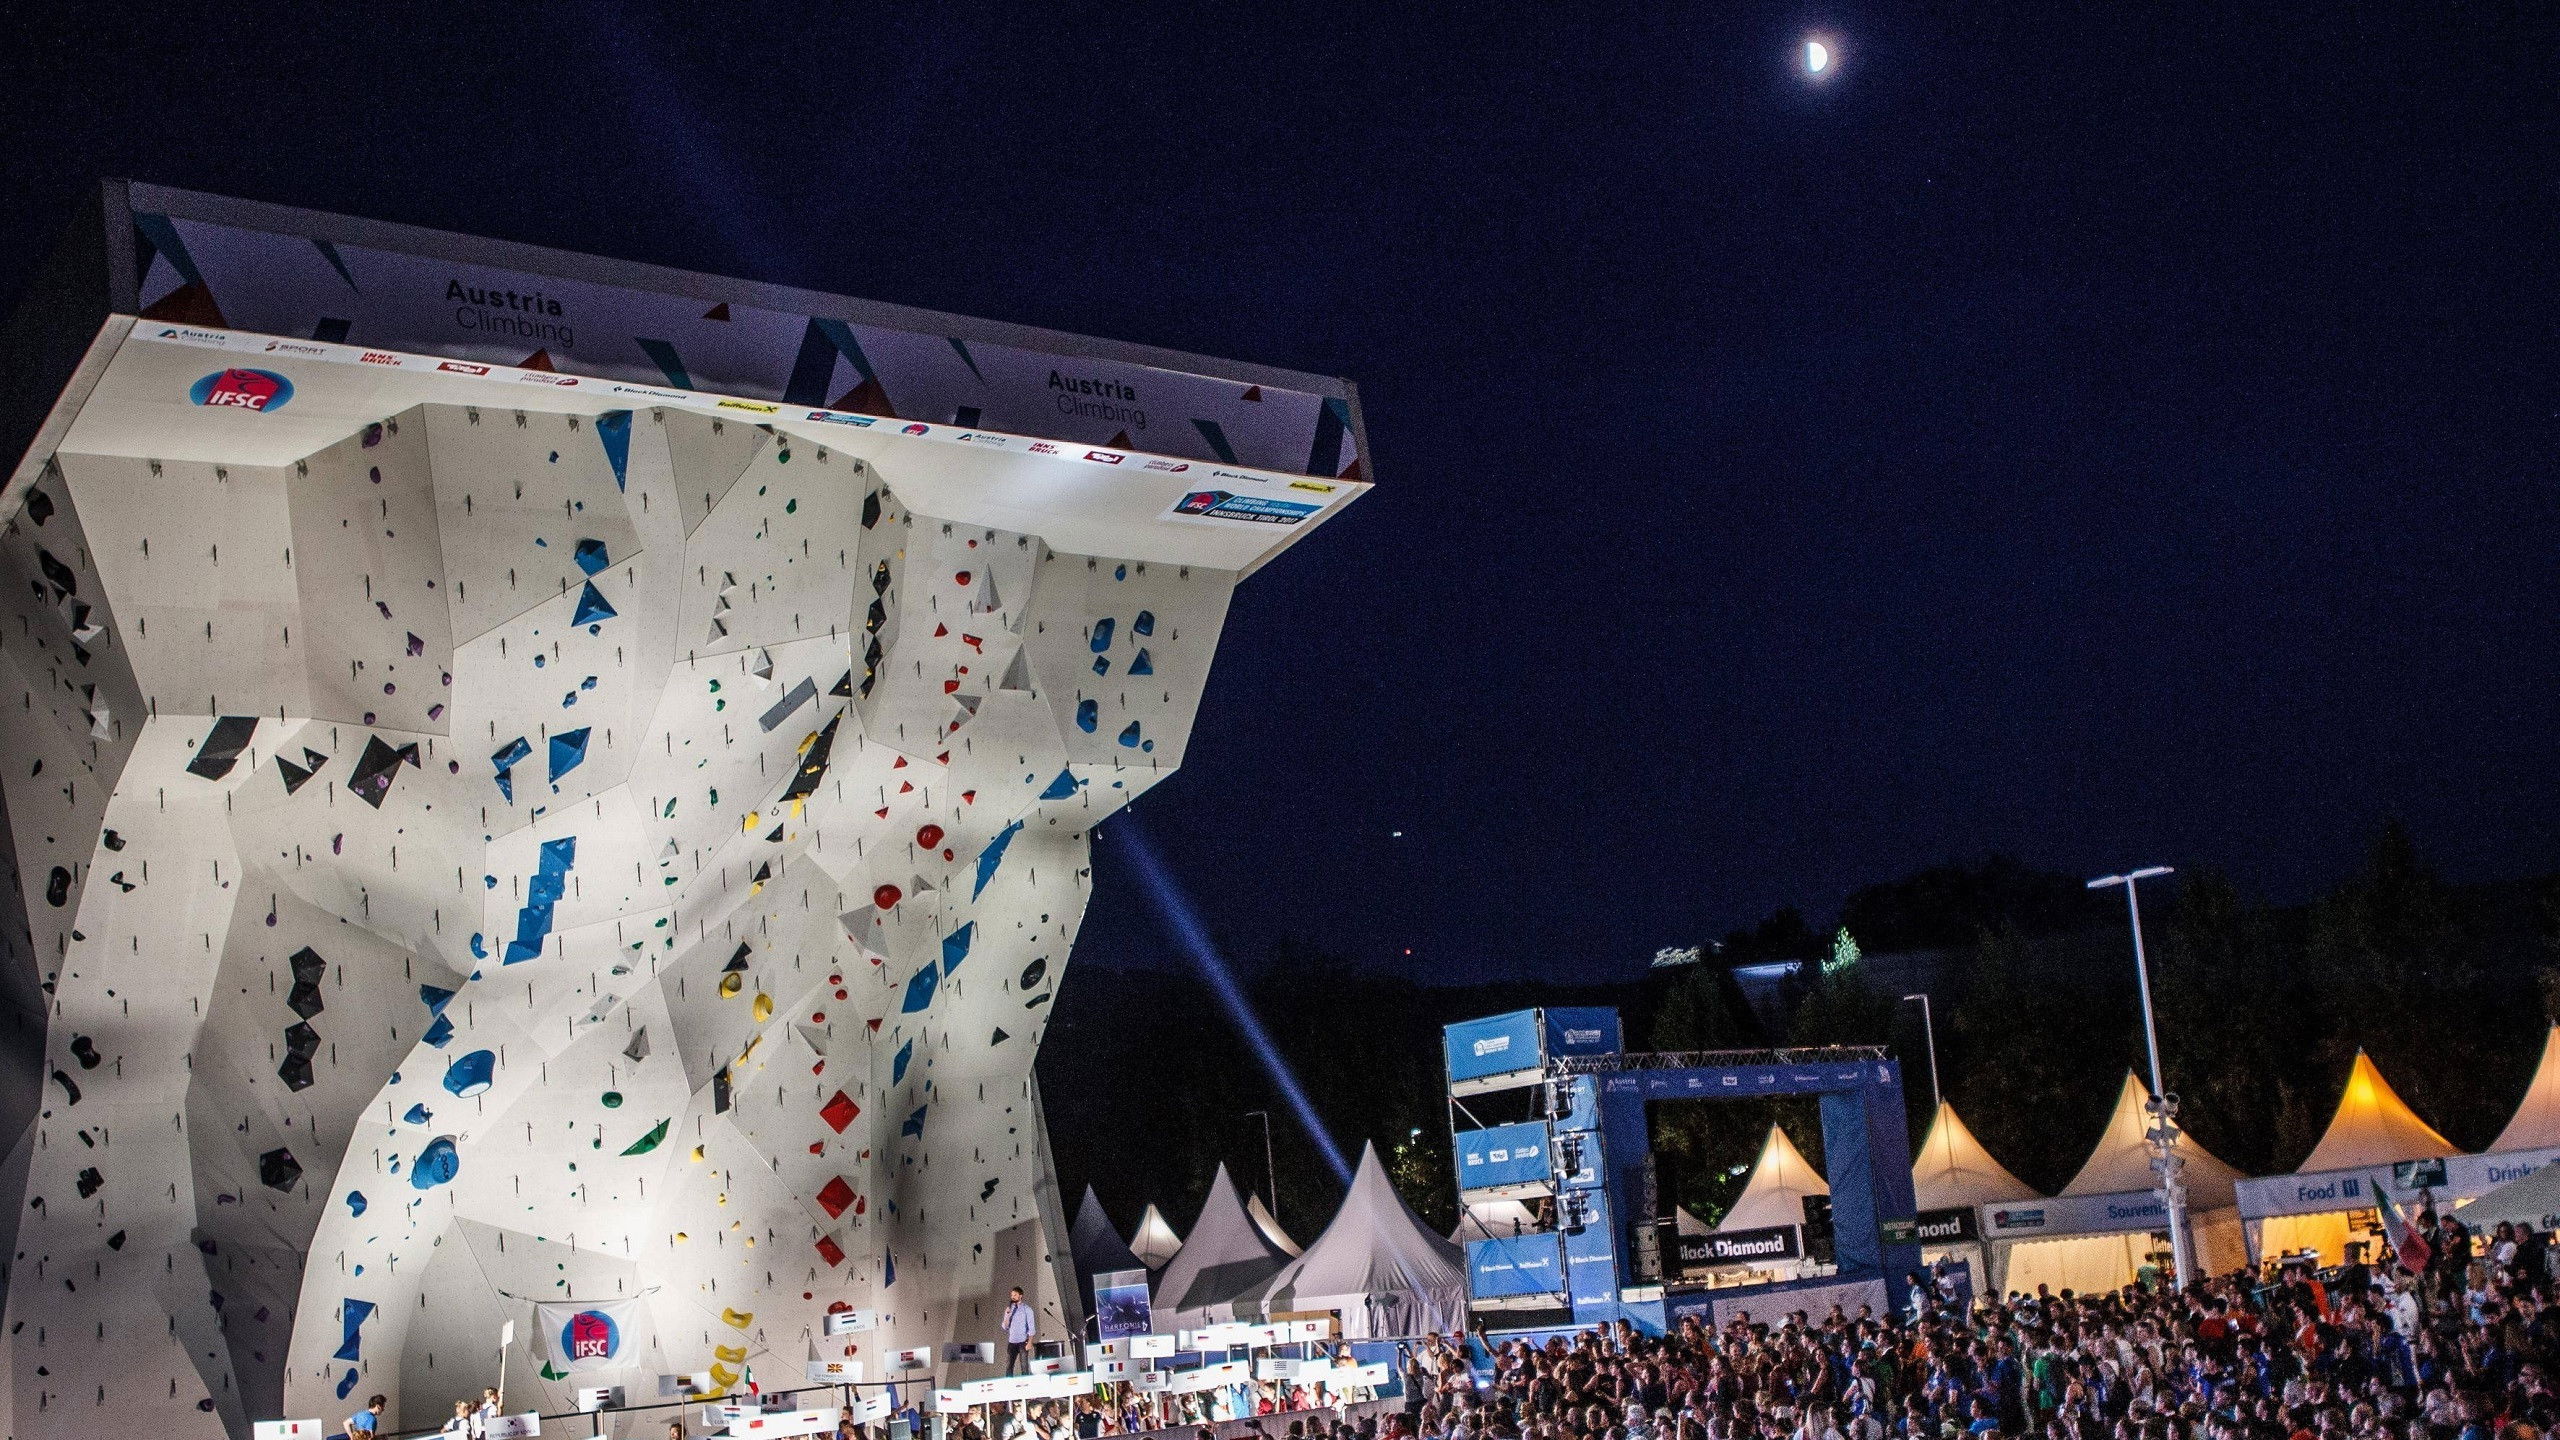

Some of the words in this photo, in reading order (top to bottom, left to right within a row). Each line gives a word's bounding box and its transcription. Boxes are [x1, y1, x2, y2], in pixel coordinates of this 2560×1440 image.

[446, 279, 563, 317] Austria
[456, 305, 574, 349] Climbing
[181, 329, 226, 341] Austria
[1049, 370, 1136, 401] Austria
[210, 390, 267, 409] IFSC
[624, 387, 647, 395] Black
[649, 390, 687, 400] Diamond
[717, 401, 763, 412] Raiffeisen
[1057, 394, 1147, 430] Climbing
[975, 433, 1007, 442] Austria
[1028, 446, 1058, 455] BRUCK
[1220, 472, 1240, 480] Black
[1240, 475, 1269, 484] Diamond
[1210, 509, 1254, 520] INNSBRUCK
[1255, 514, 1280, 522] TIROL
[1281, 516, 1299, 524] 2017
[1223, 503, 1252, 513] WORLD
[1252, 505, 1307, 517] CHAMPIONSHIPS
[2299, 1183, 2334, 1201] Food
[1715, 1235, 1785, 1257] Diamond
